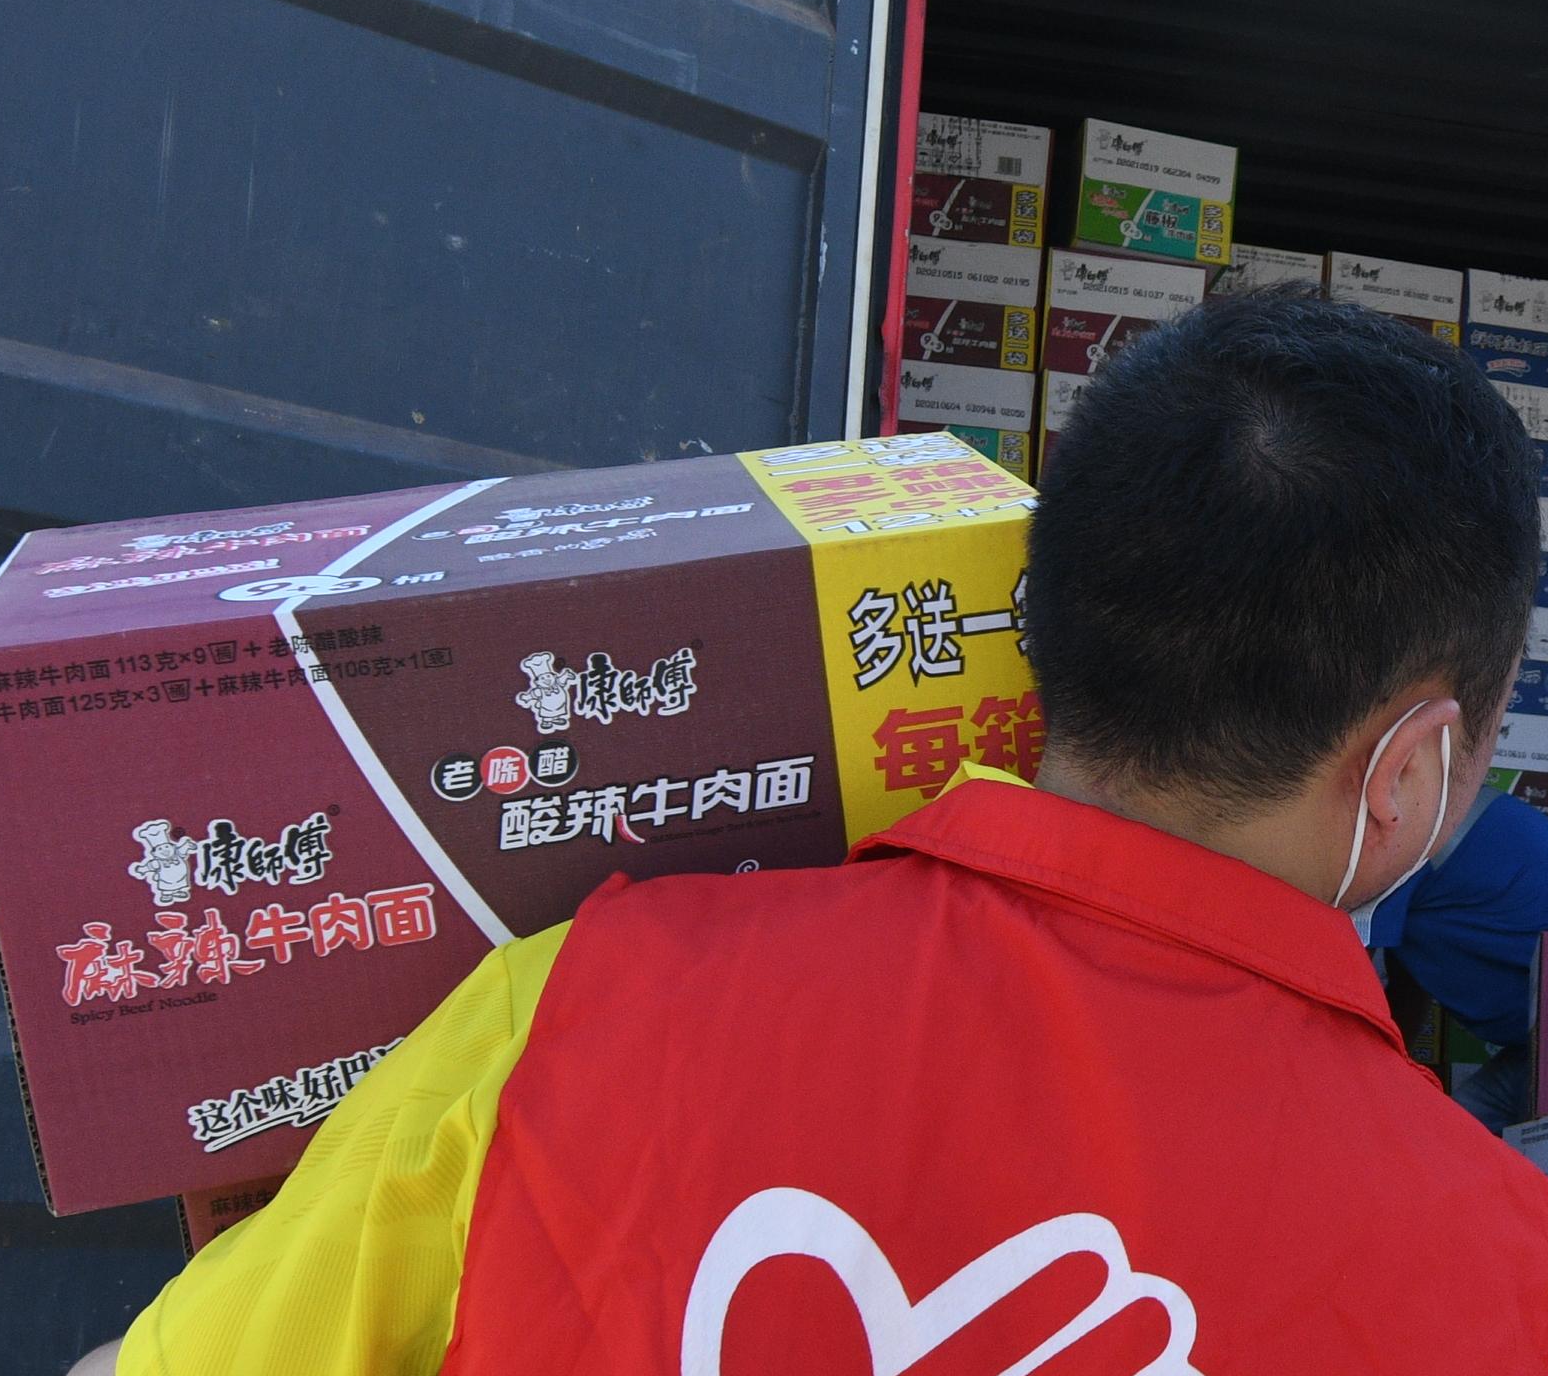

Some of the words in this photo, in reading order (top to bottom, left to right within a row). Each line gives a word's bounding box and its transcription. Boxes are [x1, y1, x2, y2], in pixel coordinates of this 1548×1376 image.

[848, 568, 1029, 691] 多送一
[437, 741, 572, 794] 老陈醋
[500, 756, 817, 851] 酸辣牛肉面
[56, 883, 437, 1007] 麻辣牛肉面
[70, 1004, 115, 1026] Spicy
[158, 990, 218, 1012] Noodle
[189, 1038, 405, 1140] 这个味好巴
